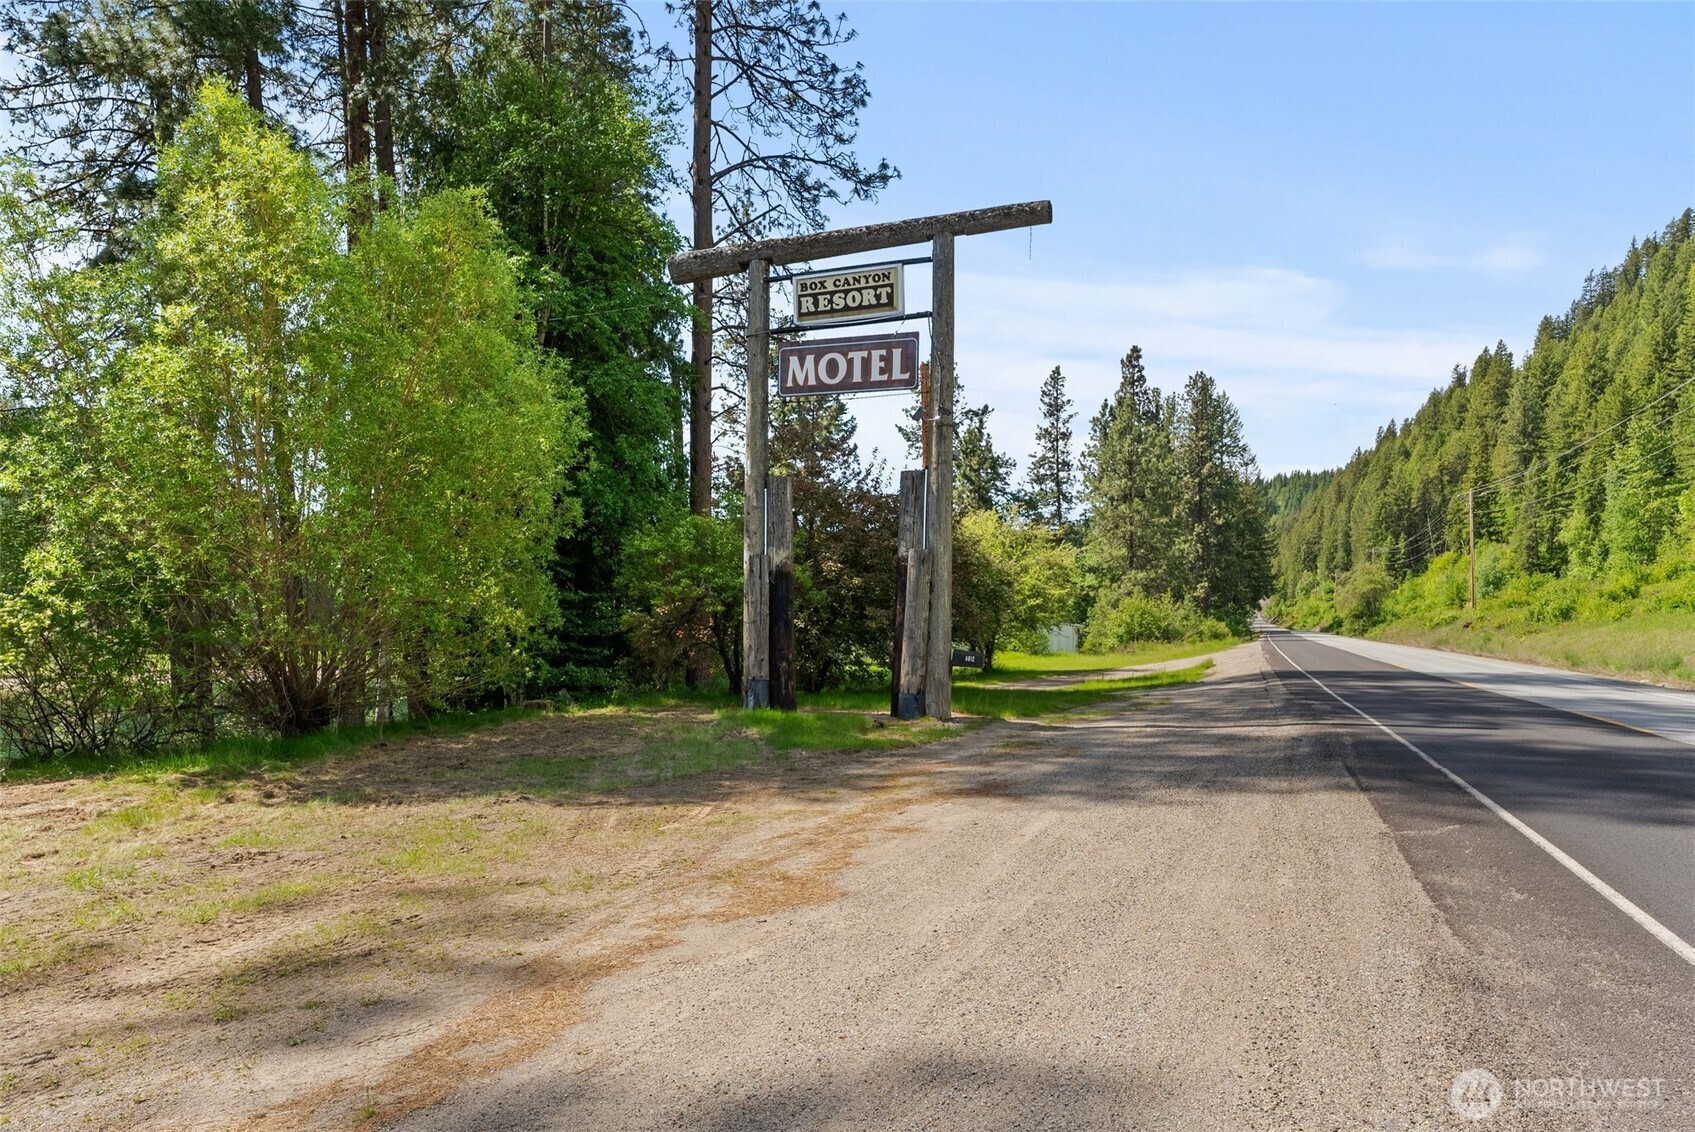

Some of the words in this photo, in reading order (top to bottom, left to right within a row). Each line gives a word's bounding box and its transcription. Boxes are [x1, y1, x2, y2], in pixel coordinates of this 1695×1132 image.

[800, 279, 828, 292] BOX
[833, 272, 892, 288] CANYON
[800, 286, 892, 313] RESORT
[786, 348, 910, 387] MOTEL
